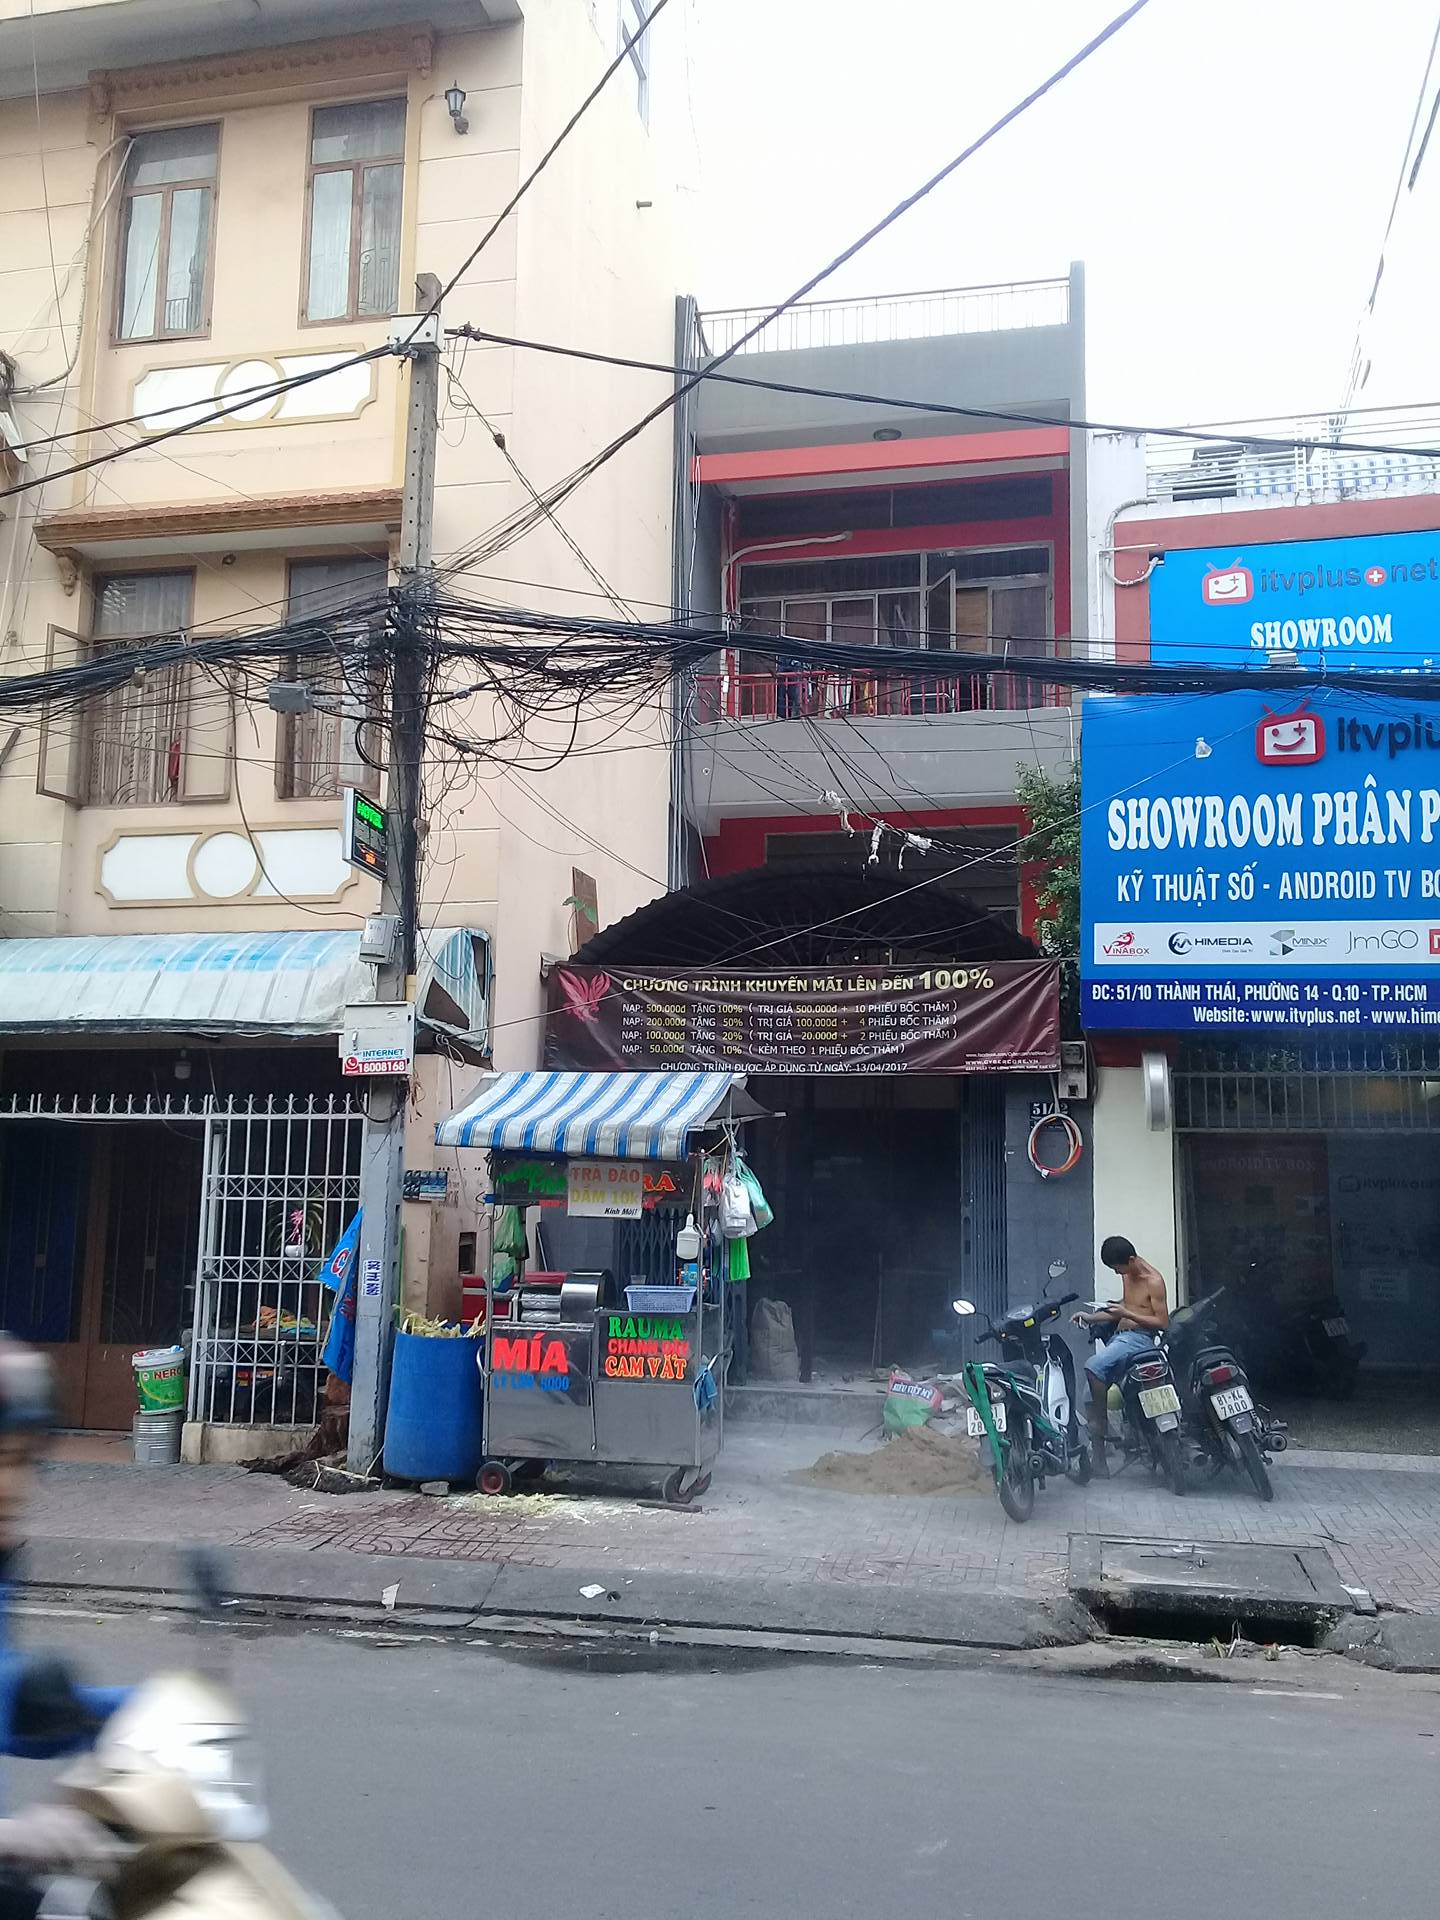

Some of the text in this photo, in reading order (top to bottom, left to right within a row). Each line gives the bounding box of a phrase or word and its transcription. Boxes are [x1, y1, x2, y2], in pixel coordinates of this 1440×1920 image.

[1250, 613, 1393, 650] SHOWROOM
[1107, 792, 1304, 851] SHOWROOM
[1312, 773, 1412, 845] PHÂN
[1117, 869, 1144, 902] KỸ
[1152, 866, 1220, 907] THUẬT
[1227, 861, 1257, 901] SỐ
[1279, 871, 1376, 900] ANDROID
[1384, 869, 1411, 898] TV
[1194, 937, 1254, 946] HIMEDIA
[1292, 937, 1328, 945] MINIX
[623, 968, 994, 992] CHƯƠNG TRÌNH KHUYẾN MÃI LÊN ĐẾN 100%
[1155, 981, 1201, 1001] THÀNH
[1205, 981, 1241, 1003] THÁI,
[1244, 980, 1300, 1001] PHƯỜNG
[1303, 984, 1319, 1001] 14
[1332, 984, 1360, 1002] Q.10
[1371, 984, 1428, 1001] TP.HCM
[690, 1002, 716, 1015] TẶNG
[718, 1004, 743, 1014] 100%
[757, 1004, 774, 1015] TRỊ
[776, 1002, 793, 1014] GIÁ
[855, 1004, 866, 1013] 10
[922, 1001, 950, 1013] THĂM
[690, 1015, 716, 1028] TẶNG
[722, 1018, 744, 1027] 50%
[757, 1018, 773, 1029] TRỊ
[775, 1015, 793, 1027] GIÁ
[859, 1017, 865, 1026] 4
[922, 1014, 950, 1026] THĂM
[690, 1029, 716, 1042] TẶNG
[722, 1031, 743, 1040] 20%
[757, 1031, 773, 1042] TRỊ
[775, 1029, 793, 1041] GIÁ
[860, 1031, 866, 1041] 2
[922, 1028, 950, 1040] THĂM
[362, 1048, 405, 1058] INTERNET
[690, 1043, 716, 1056] TẶNG
[722, 1045, 743, 1054] 10%
[758, 1043, 778, 1055] KÈM
[780, 1045, 806, 1055] THEO
[811, 1046, 816, 1055] 1
[872, 1044, 899, 1054] THĂM
[358, 1061, 405, 1073] 18008168
[660, 1061, 908, 1074] CHƯƠNG TRÌNH ĐƯỢC ÁP DỤNG TỪ NGÀY: 13/04/2017
[1032, 1102, 1069, 1115] 51/2
[492, 1332, 569, 1374] MÍA
[604, 1355, 644, 1378] CAM
